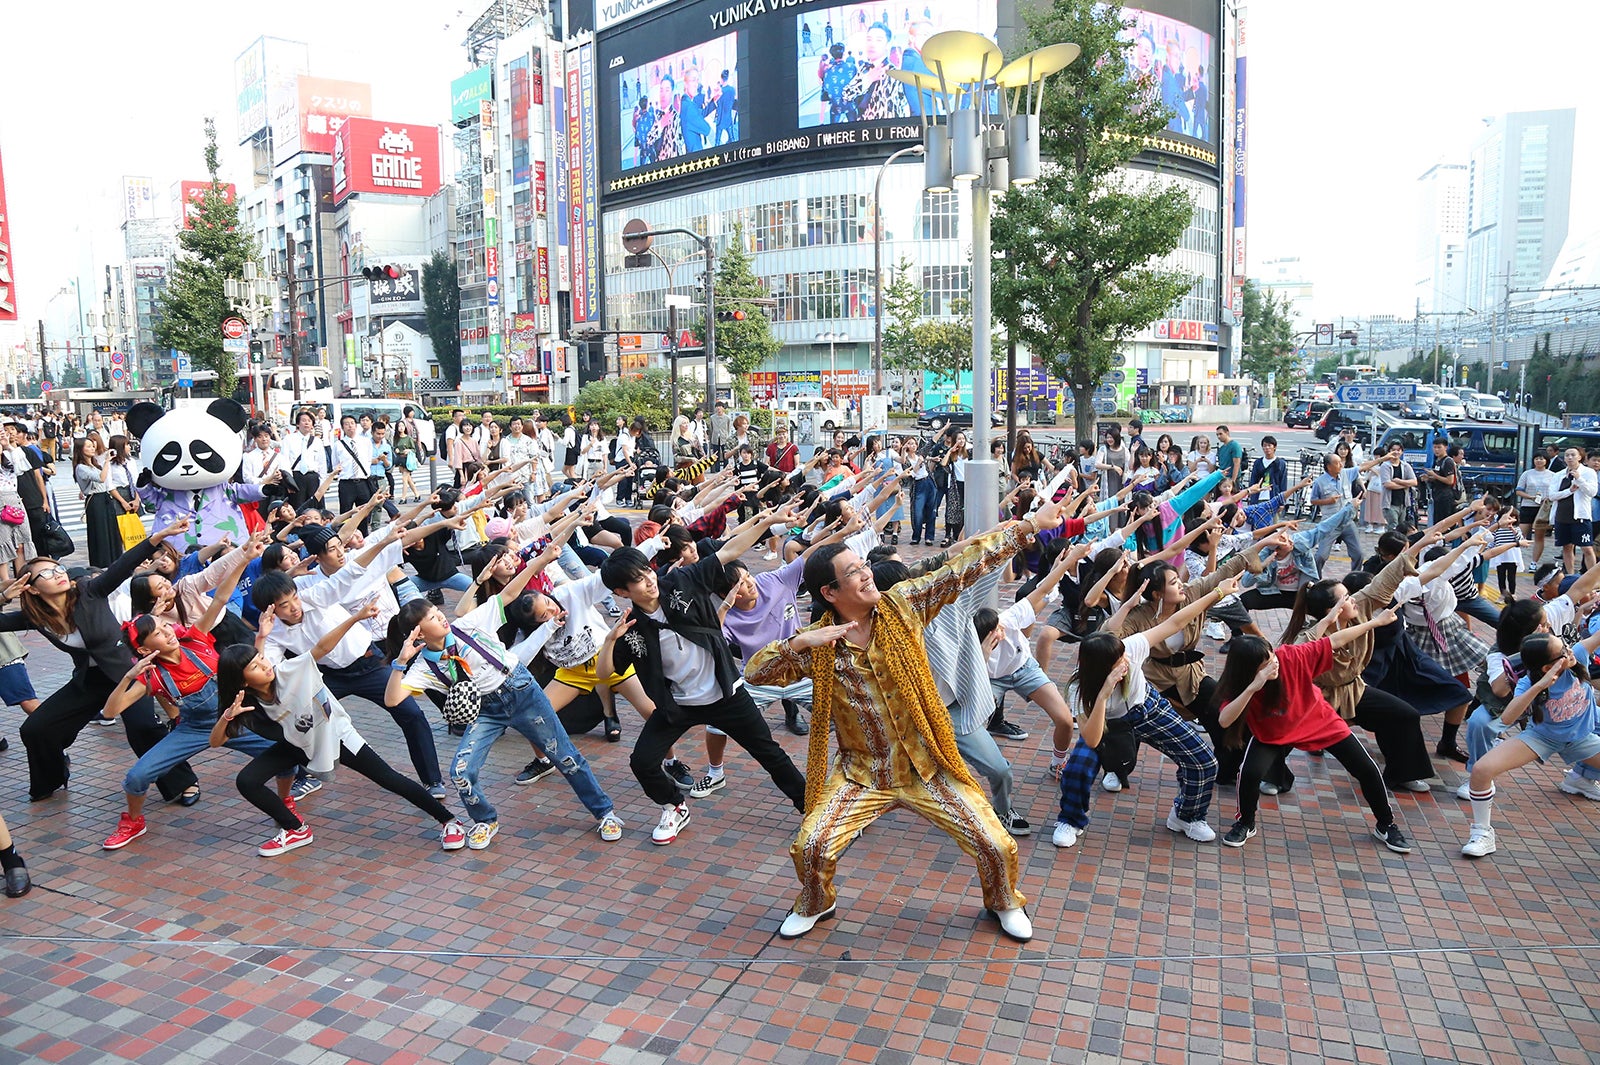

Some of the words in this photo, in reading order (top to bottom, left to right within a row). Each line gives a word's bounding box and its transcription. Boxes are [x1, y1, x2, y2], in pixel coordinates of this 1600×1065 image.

[709, 0, 766, 30] YUNIKA
[311, 95, 361, 112] クスリの
[571, 118, 580, 149] TAX
[862, 129, 869, 141] R
[875, 128, 883, 140] U
[890, 126, 919, 139] FROM
[371, 153, 423, 181] GAME
[558, 188, 566, 202] For
[572, 169, 582, 206] FREE
[488, 249, 496, 276] アイフル
[1169, 320, 1203, 340] LABI
[179, 359, 188, 370] P
[1366, 387, 1407, 396] 靖国通り
